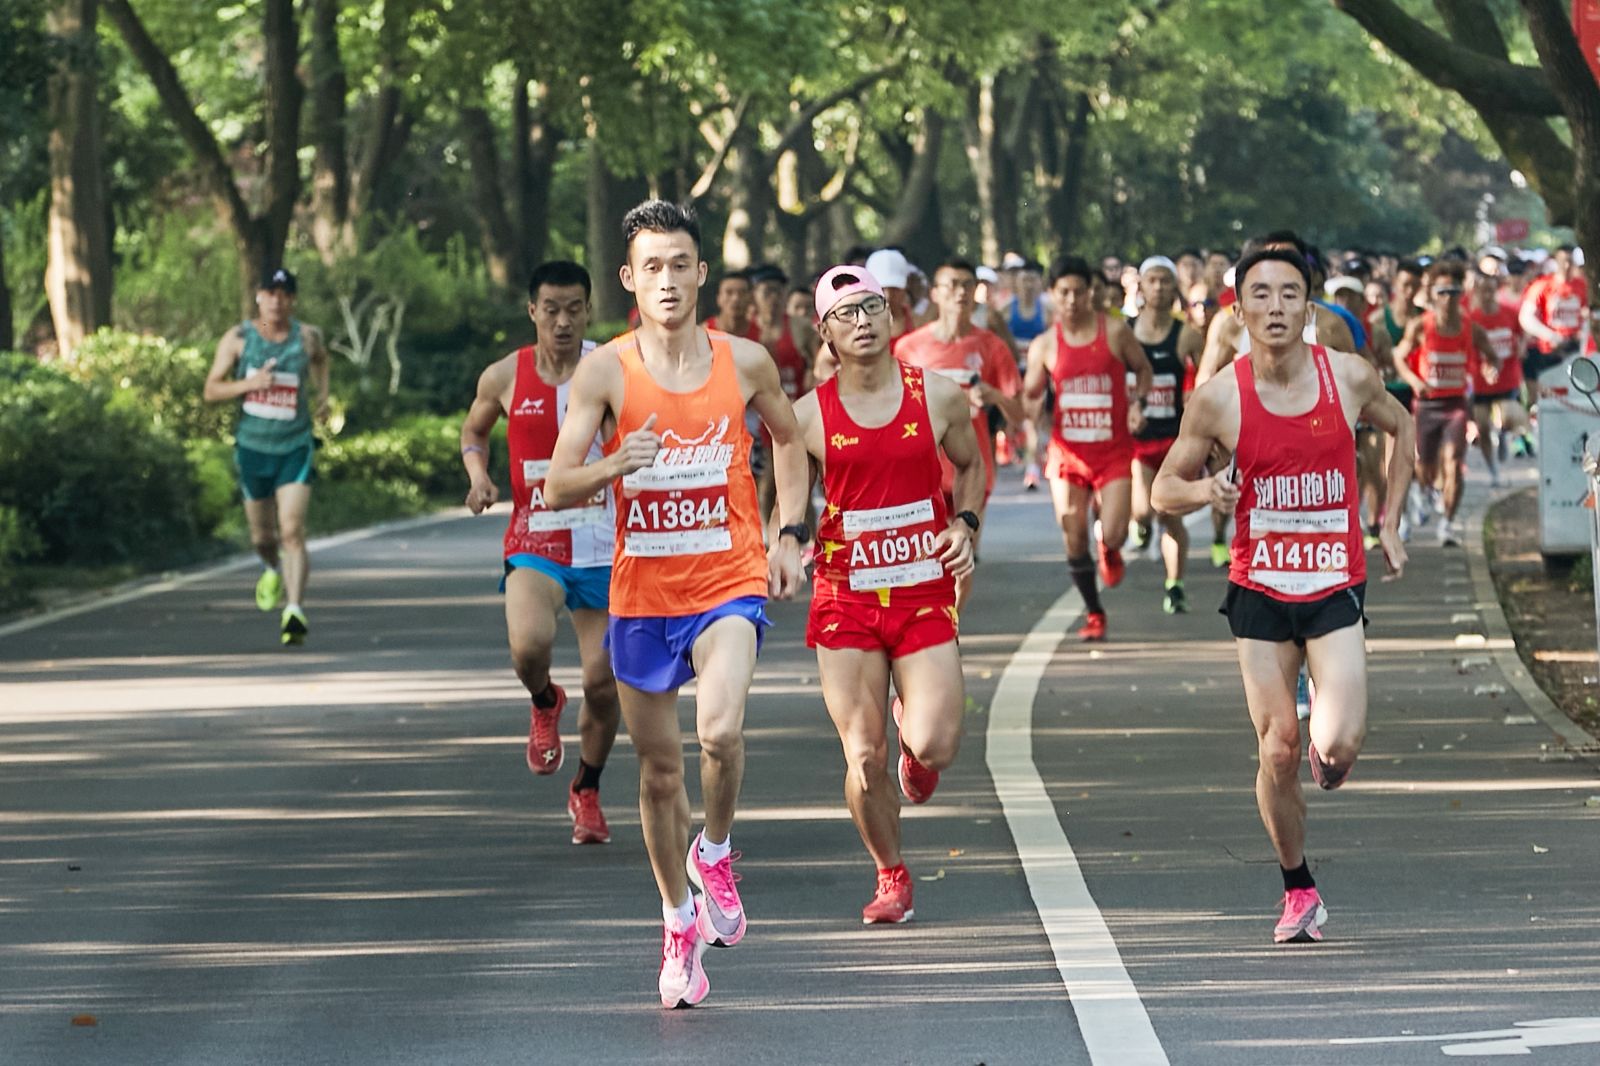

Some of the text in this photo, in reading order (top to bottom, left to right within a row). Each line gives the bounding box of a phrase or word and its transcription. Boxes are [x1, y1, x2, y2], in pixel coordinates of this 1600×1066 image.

[1253, 468, 1345, 509] 浏阳跑协
[626, 495, 728, 530] A13844
[850, 530, 937, 567] A10910
[1251, 539, 1347, 570] A14166
